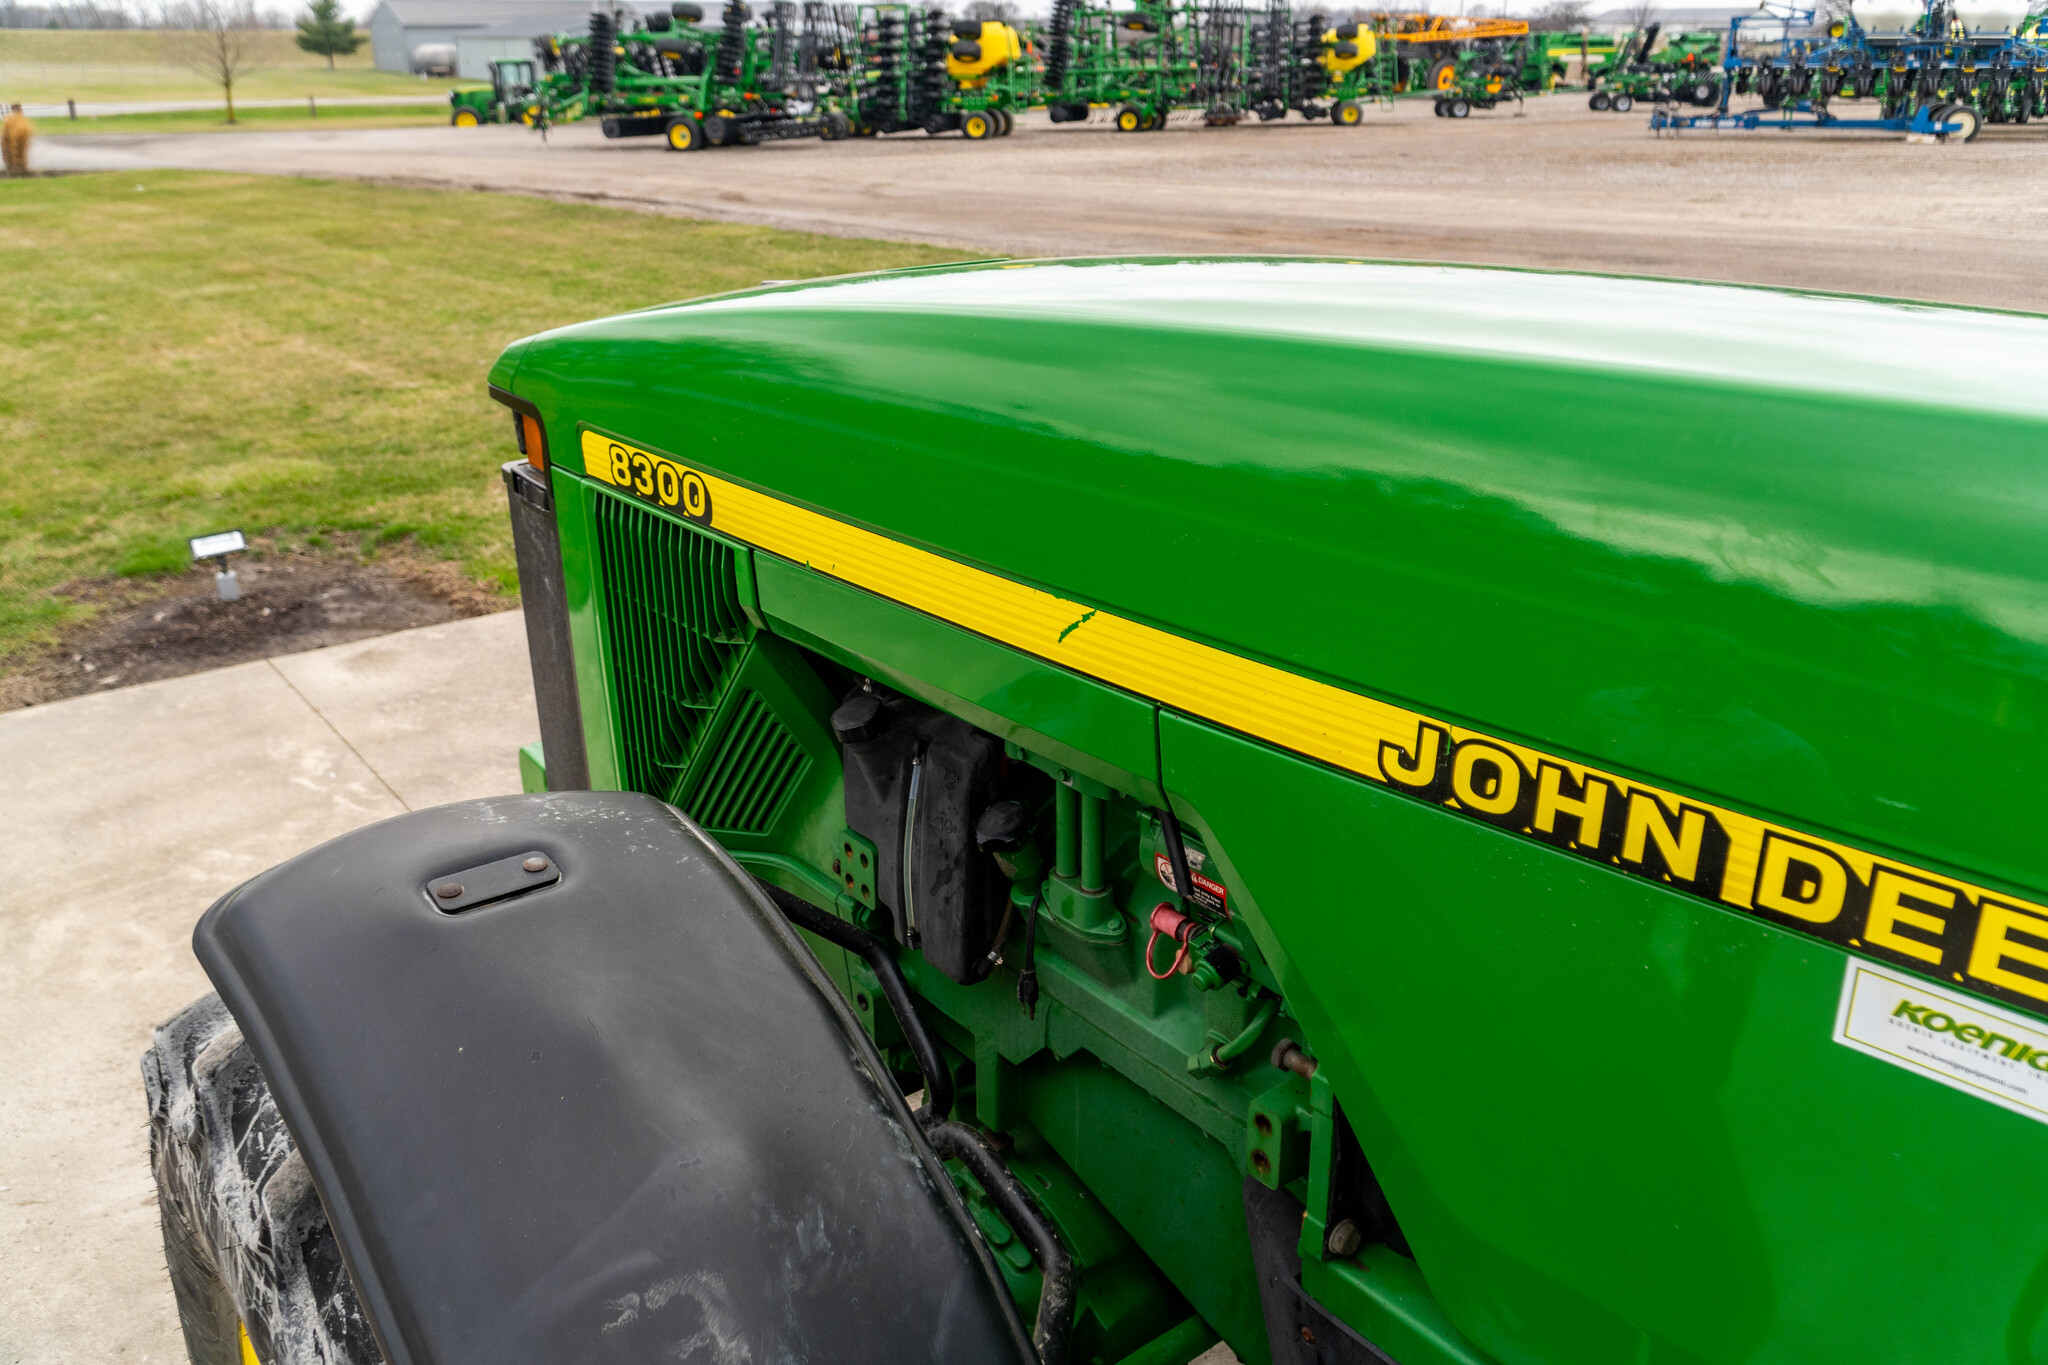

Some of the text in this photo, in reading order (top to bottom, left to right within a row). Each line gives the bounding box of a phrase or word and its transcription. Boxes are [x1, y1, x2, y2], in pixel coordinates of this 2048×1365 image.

[609, 443, 709, 519] 8300
[1379, 722, 1706, 883] JOHN
[1198, 876, 1225, 896] DANGER
